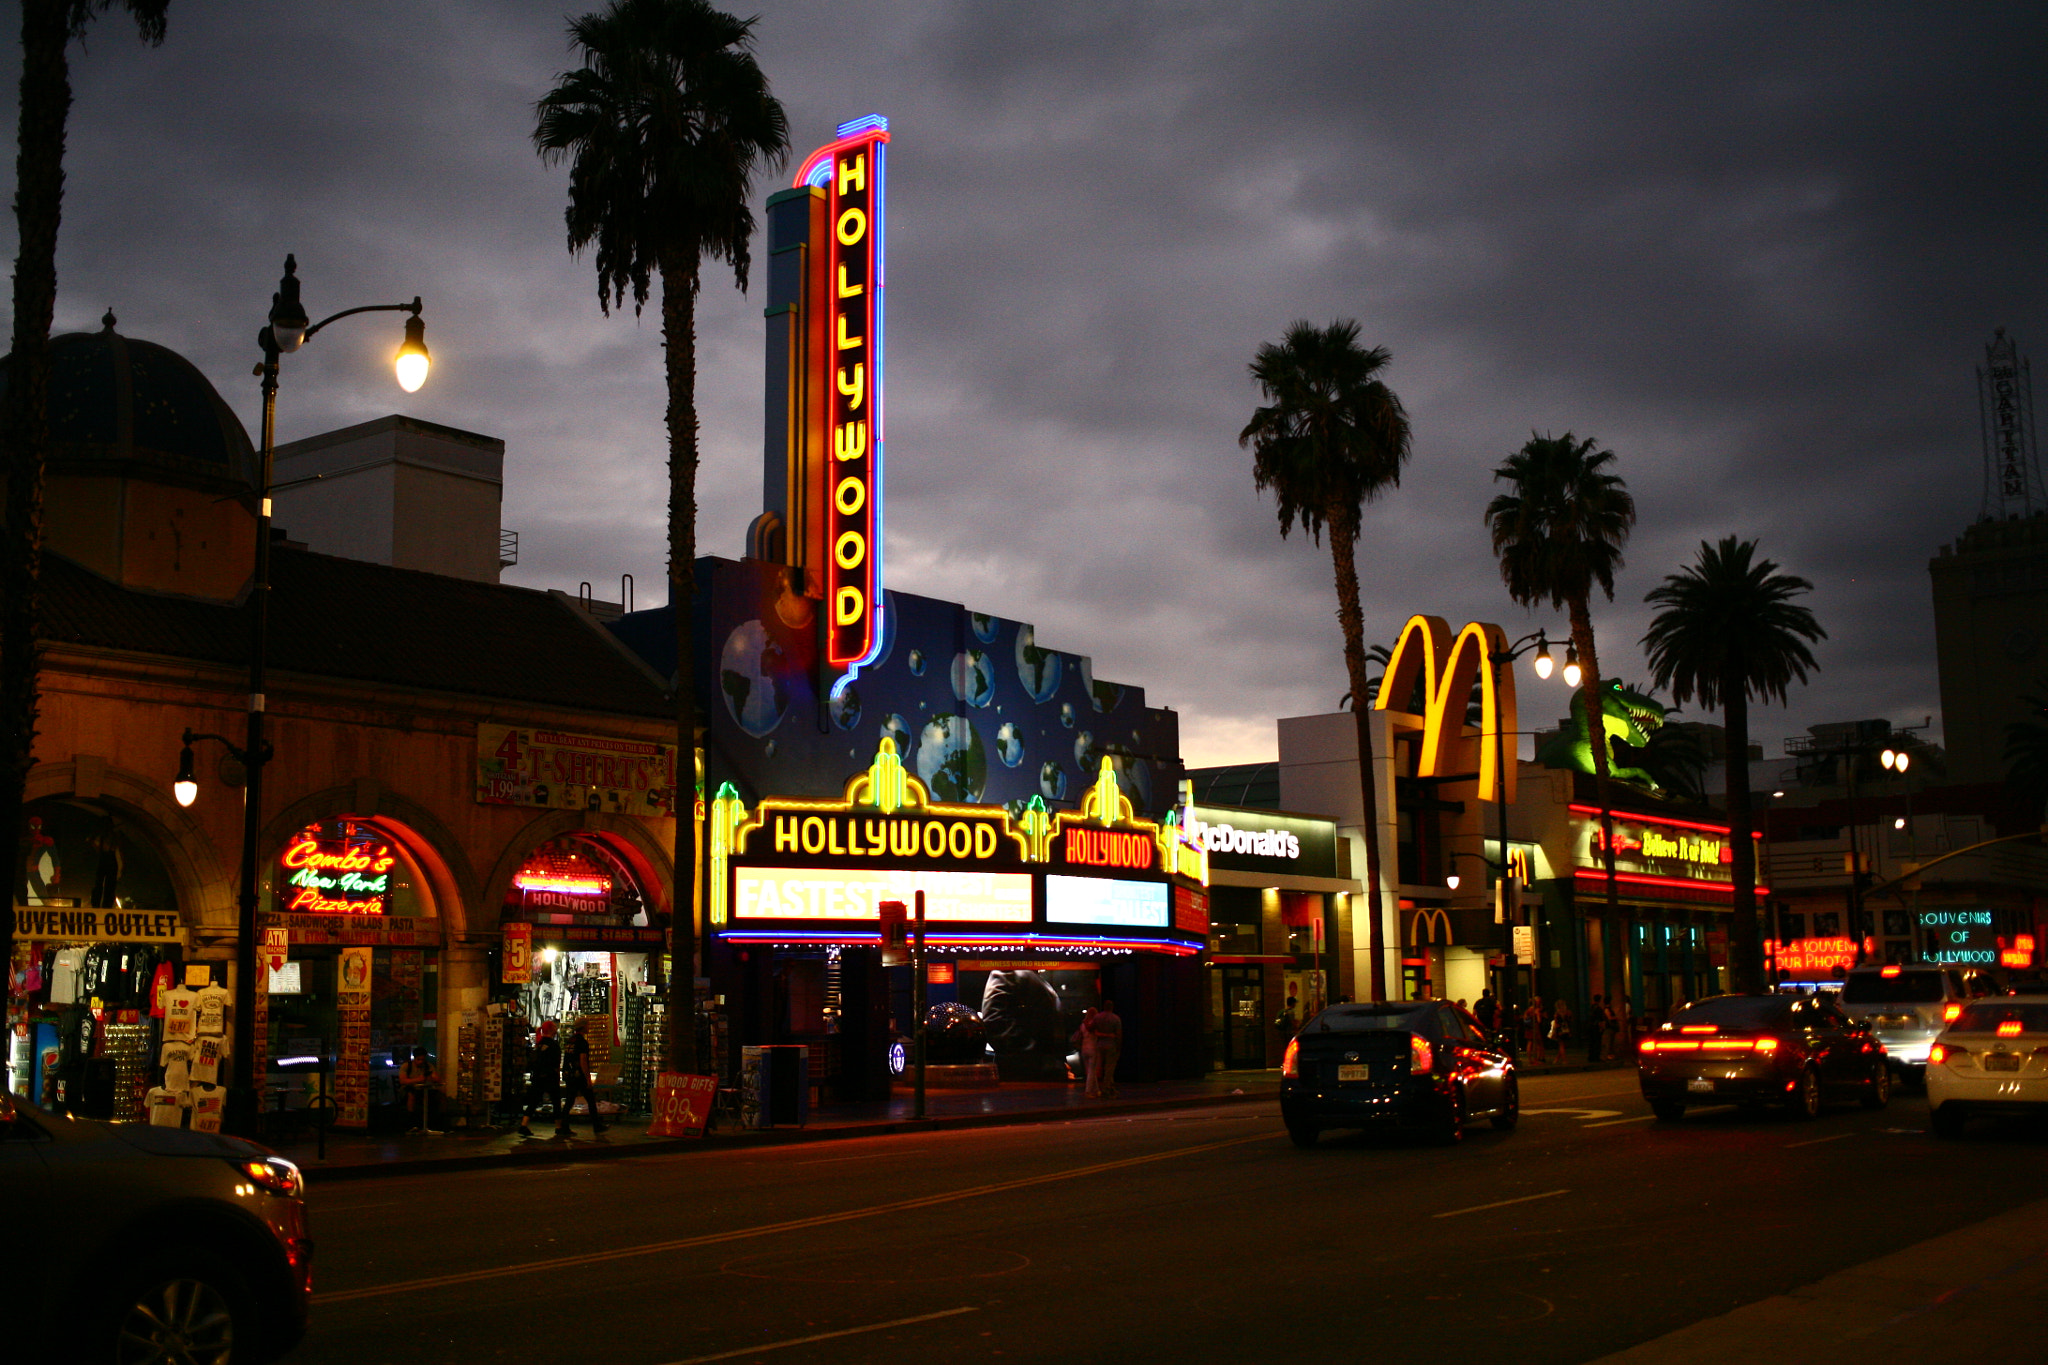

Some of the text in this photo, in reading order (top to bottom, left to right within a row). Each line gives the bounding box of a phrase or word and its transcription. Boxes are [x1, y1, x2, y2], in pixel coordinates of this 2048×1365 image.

[835, 152, 868, 627] HOLLYWOOD
[495, 730, 523, 771] 4
[528, 746, 649, 791] T-SHIRTS
[775, 815, 998, 859] HOLLYWOOD
[1065, 827, 1152, 869] HOLLYWOOD
[1643, 831, 1678, 858] Believe
[1679, 836, 1689, 859] It
[1689, 845, 1699, 861] or
[285, 841, 394, 872] Combo's
[289, 868, 388, 893] New York
[291, 891, 382, 913] Pizzeria
[533, 893, 606, 912] HOLLYWOOD
[740, 878, 888, 917] FASTEST
[104, 913, 177, 937] OUTLET
[289, 914, 344, 929] SANDWICHES
[351, 916, 383, 930] SALADS
[389, 918, 414, 931] PASTA
[600, 928, 635, 941] STARS
[267, 930, 287, 946] ATM
[1804, 938, 1872, 953] SOUVENIS
[1951, 931, 1970, 943] OF
[1011, 960, 1032, 968] WORLD
[690, 1078, 715, 1092] GIFTS
